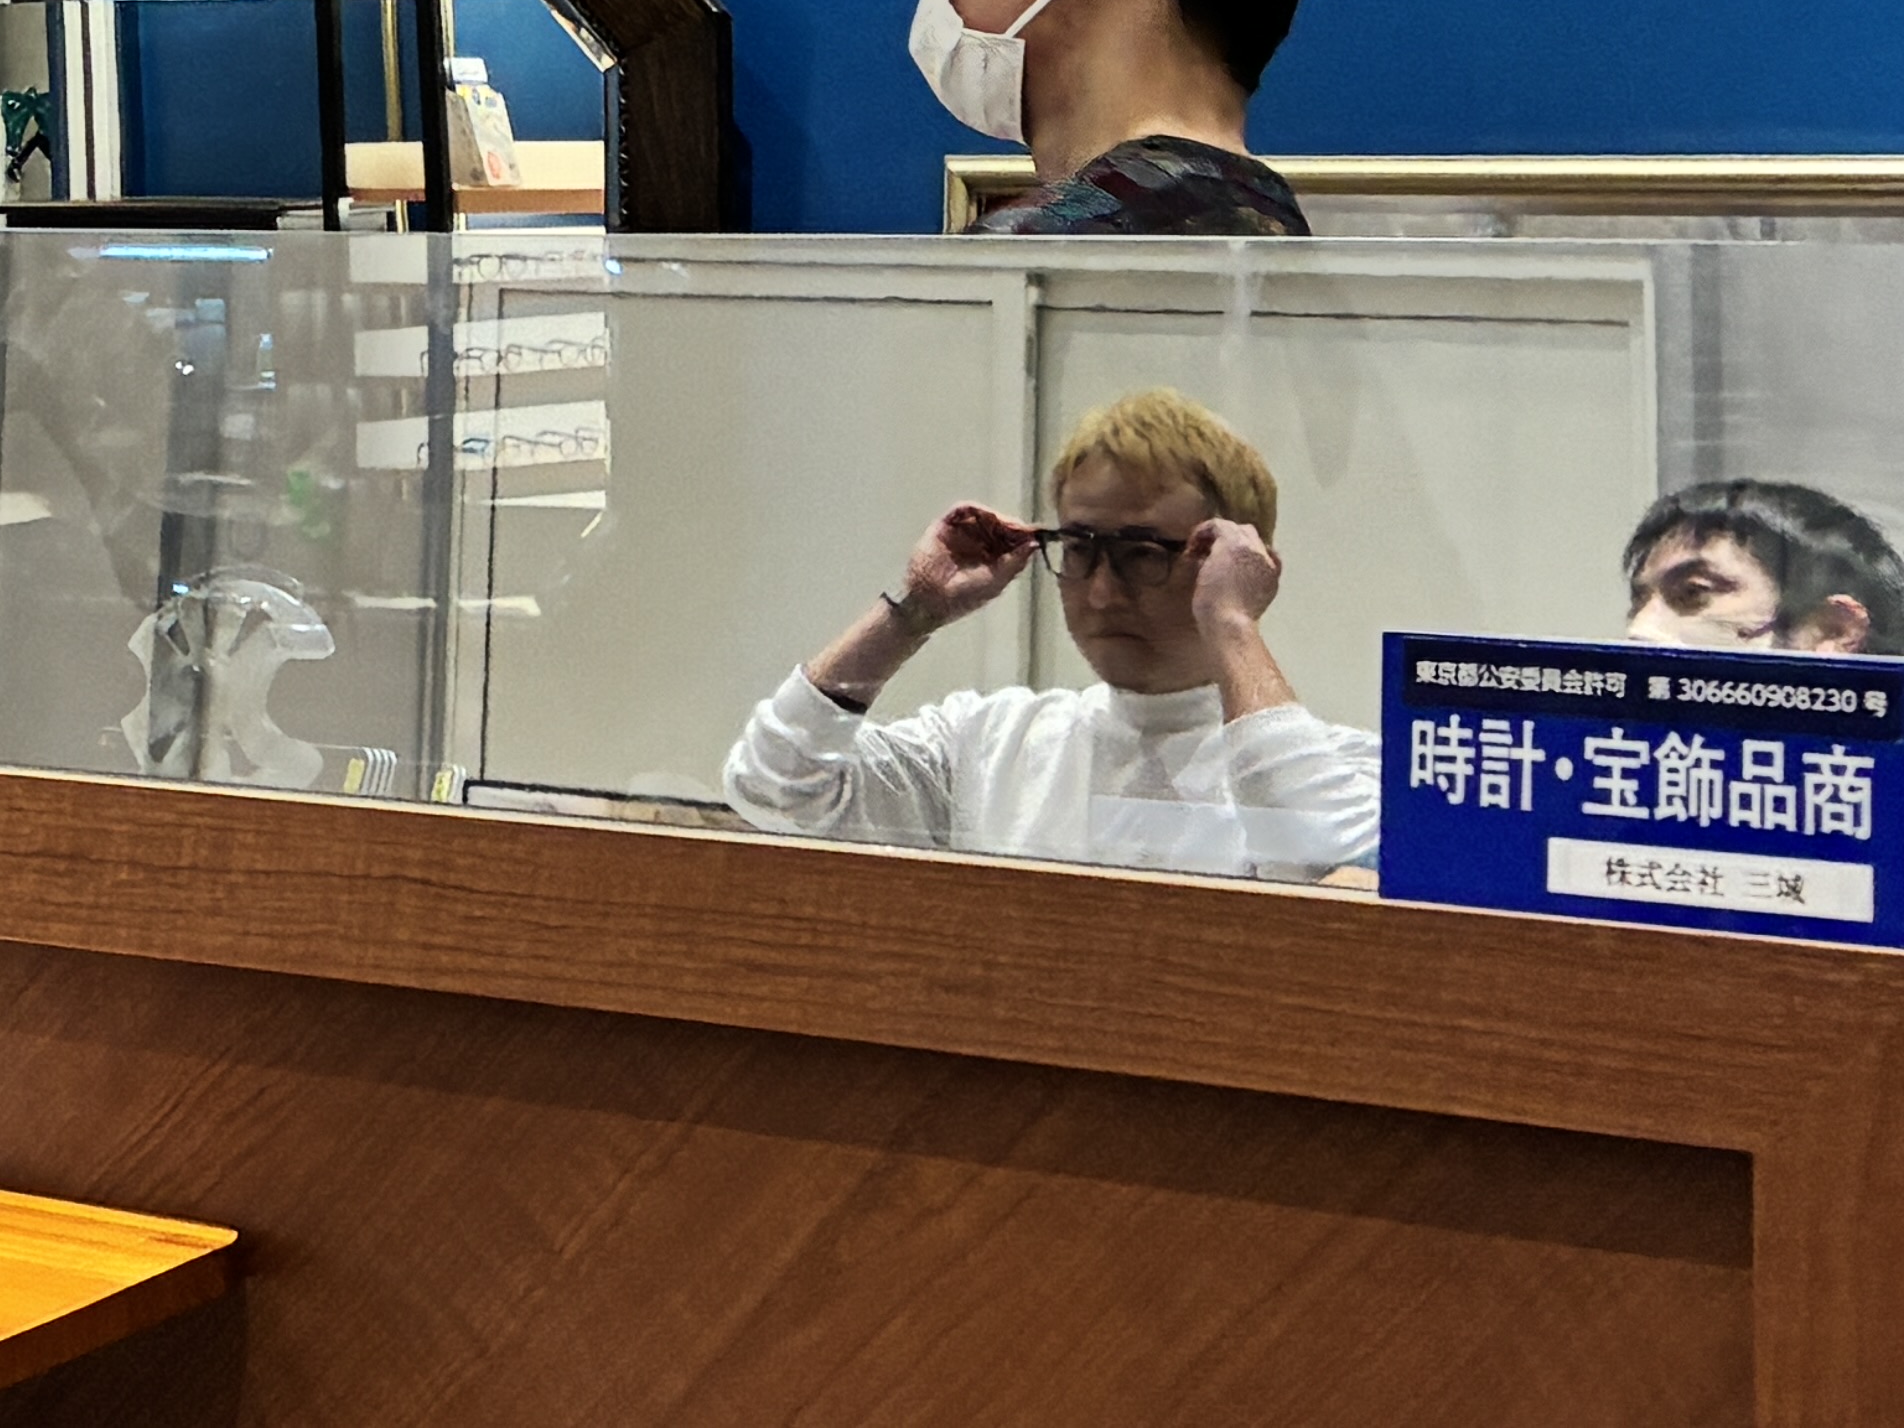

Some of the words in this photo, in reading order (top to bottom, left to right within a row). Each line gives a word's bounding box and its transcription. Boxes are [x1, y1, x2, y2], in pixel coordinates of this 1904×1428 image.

[1416, 660, 1627, 699] 東京都公安委員会許可
[1409, 714, 1875, 840] 時計・宝飾品商
[1606, 856, 1725, 898] 株式会社
